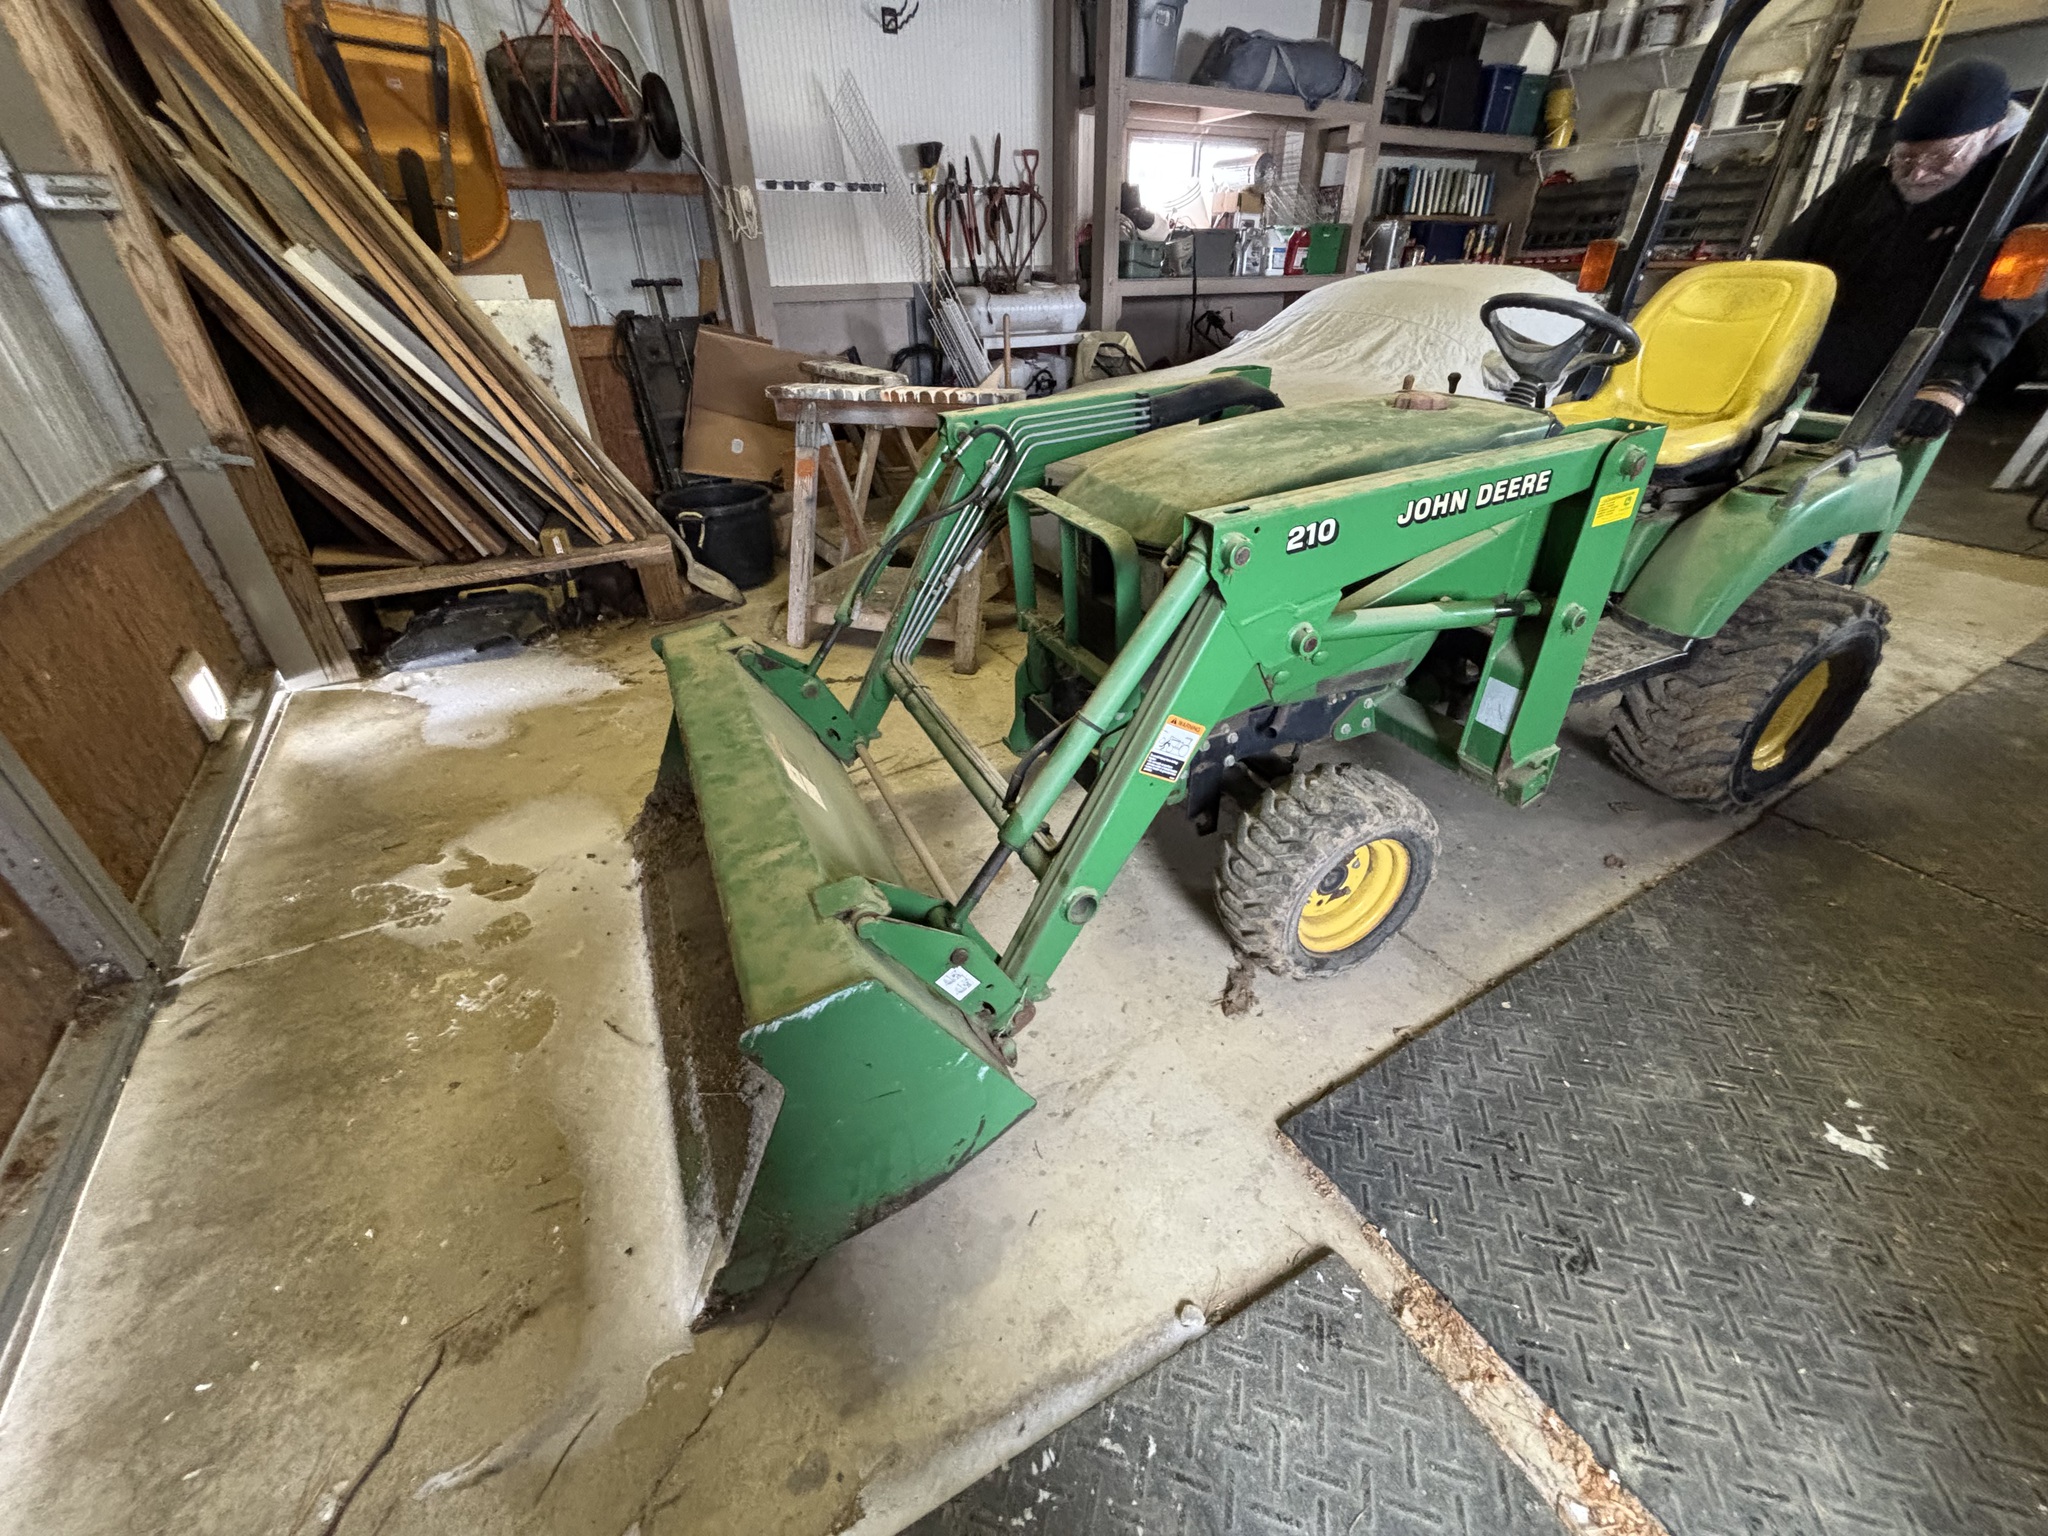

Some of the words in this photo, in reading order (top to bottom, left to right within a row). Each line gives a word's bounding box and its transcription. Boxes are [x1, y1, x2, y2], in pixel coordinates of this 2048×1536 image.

[1397, 488, 1469, 526] JOHN
[1475, 470, 1552, 508] DEERE
[1286, 518, 1338, 553] 210
[1178, 720, 1201, 732] WARNING
